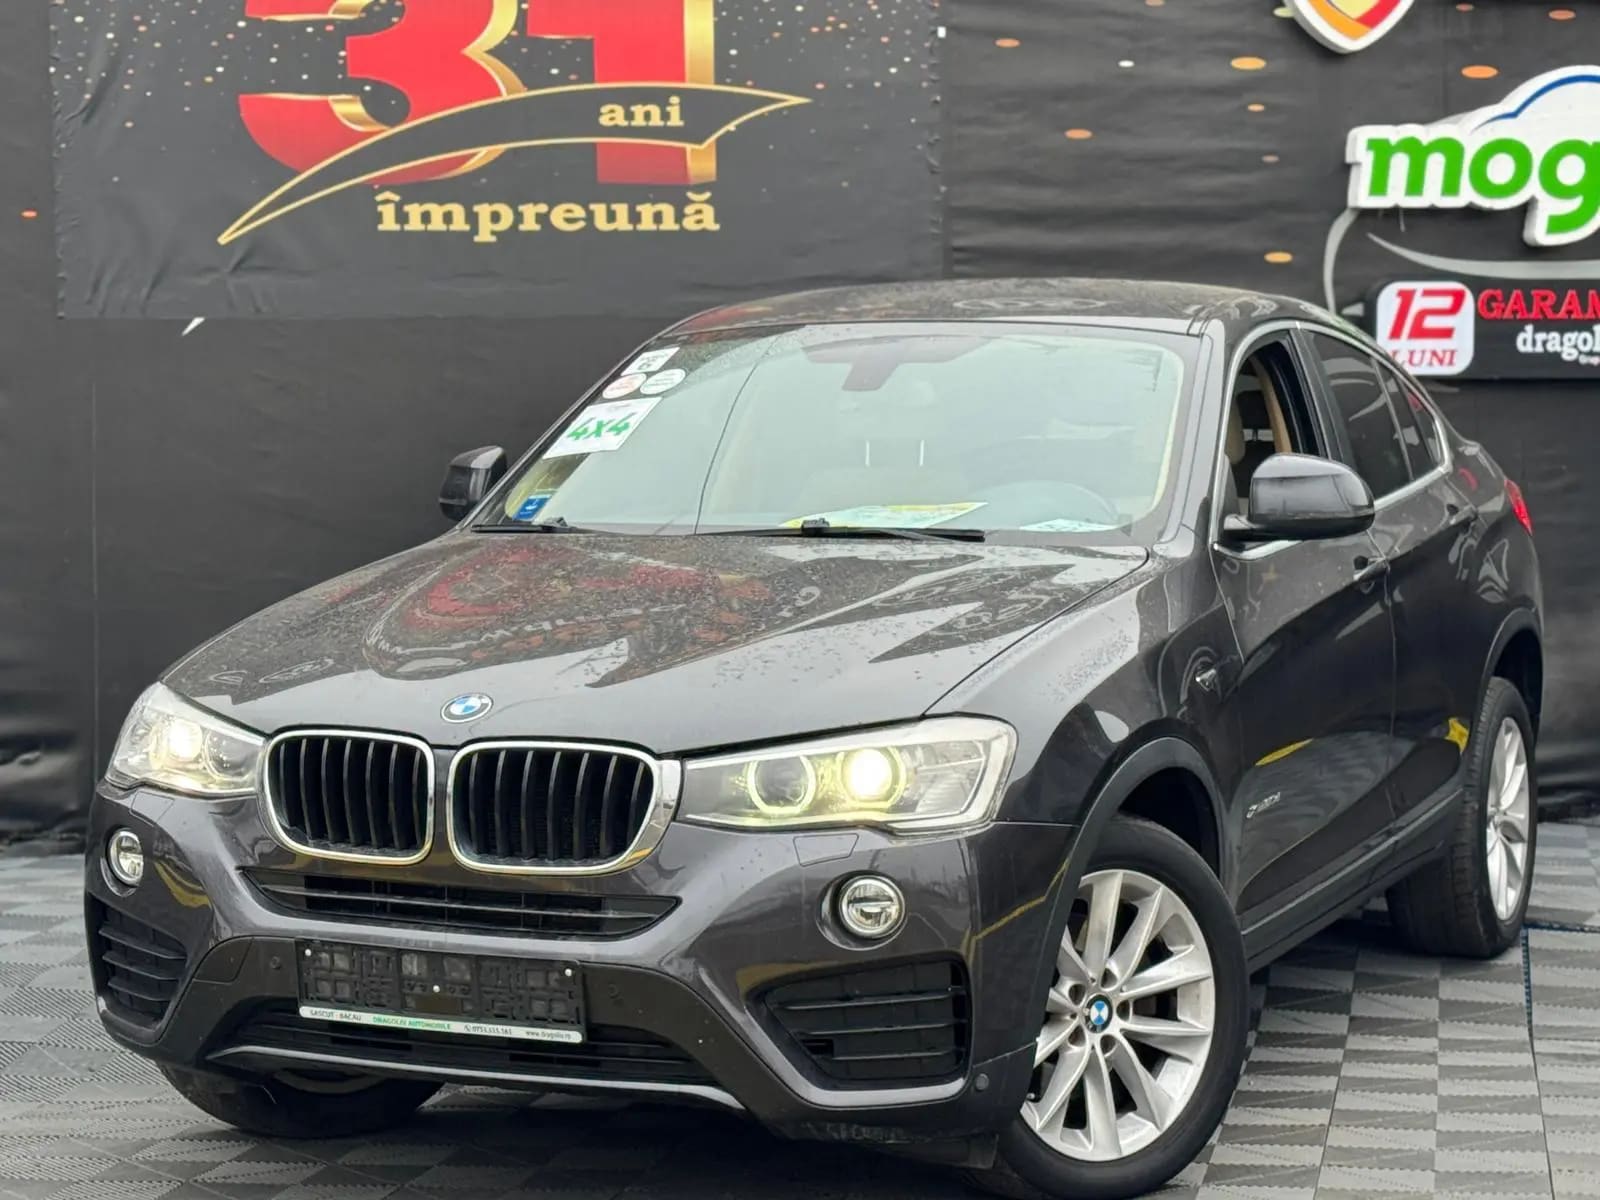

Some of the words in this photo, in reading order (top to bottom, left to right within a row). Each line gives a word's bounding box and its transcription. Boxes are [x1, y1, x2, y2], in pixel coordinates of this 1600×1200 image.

[238, 0, 717, 185] 31
[598, 96, 685, 127] ani
[1365, 136, 1600, 235] mog
[375, 191, 721, 243] împreună
[1388, 288, 1466, 340] 12
